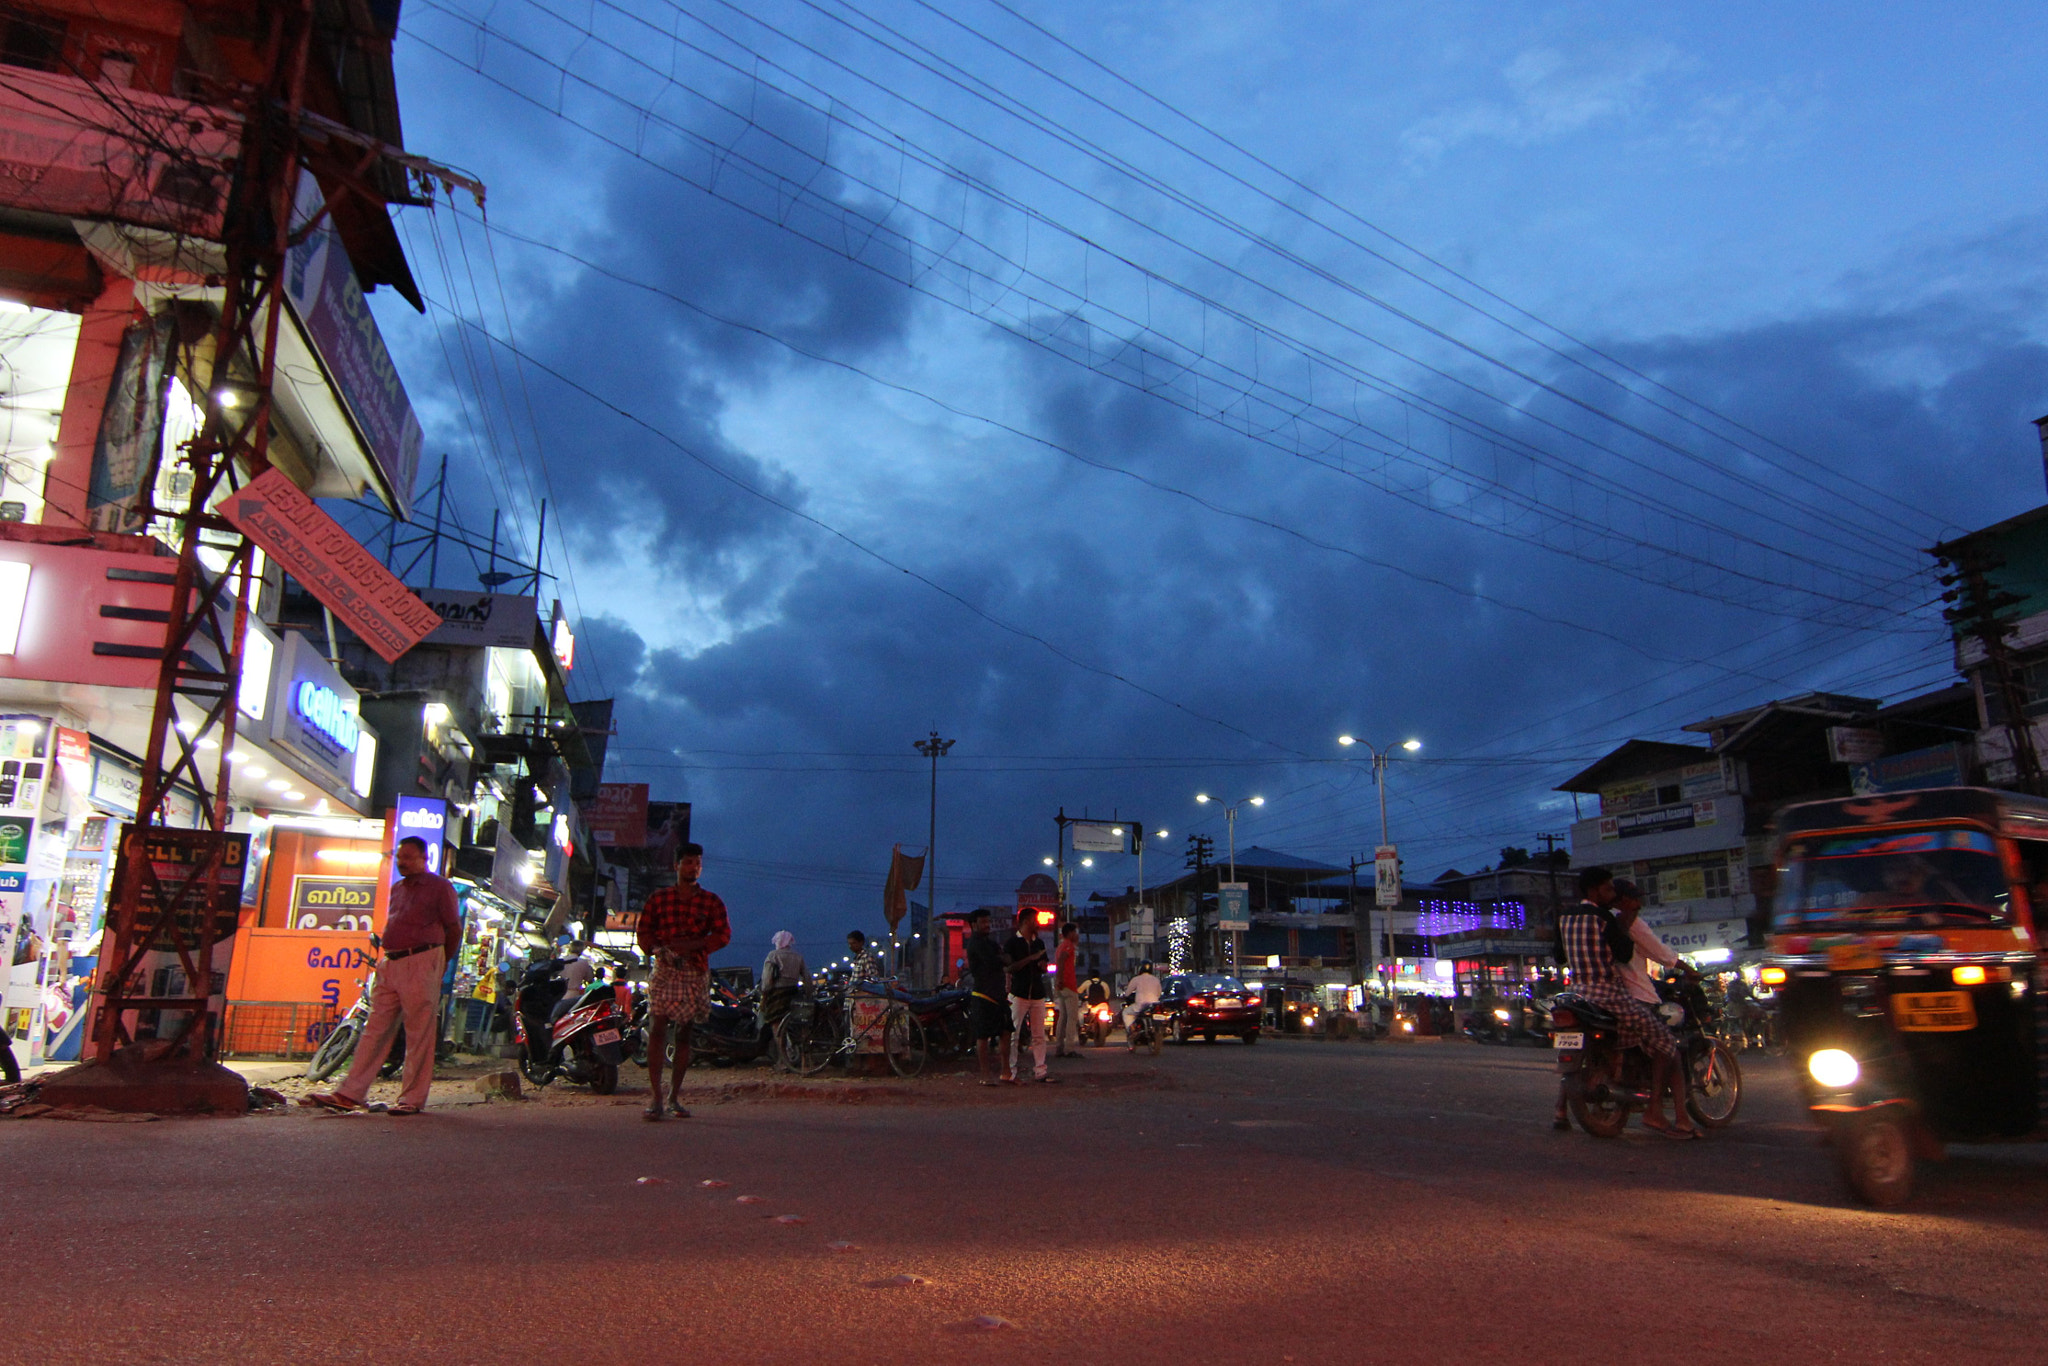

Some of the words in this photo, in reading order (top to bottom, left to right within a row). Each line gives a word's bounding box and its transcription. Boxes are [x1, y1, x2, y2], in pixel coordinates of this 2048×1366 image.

[255, 475, 319, 535] NESLIN
[315, 526, 392, 595] TOURIST
[380, 586, 437, 637] HOME
[315, 570, 348, 599] A/c
[348, 598, 406, 650] Rooms
[1600, 819, 1618, 834] ICA
[0, 876, 19, 888] ub
[307, 886, 371, 906] ബീമാ
[1662, 933, 1707, 947] Fancy
